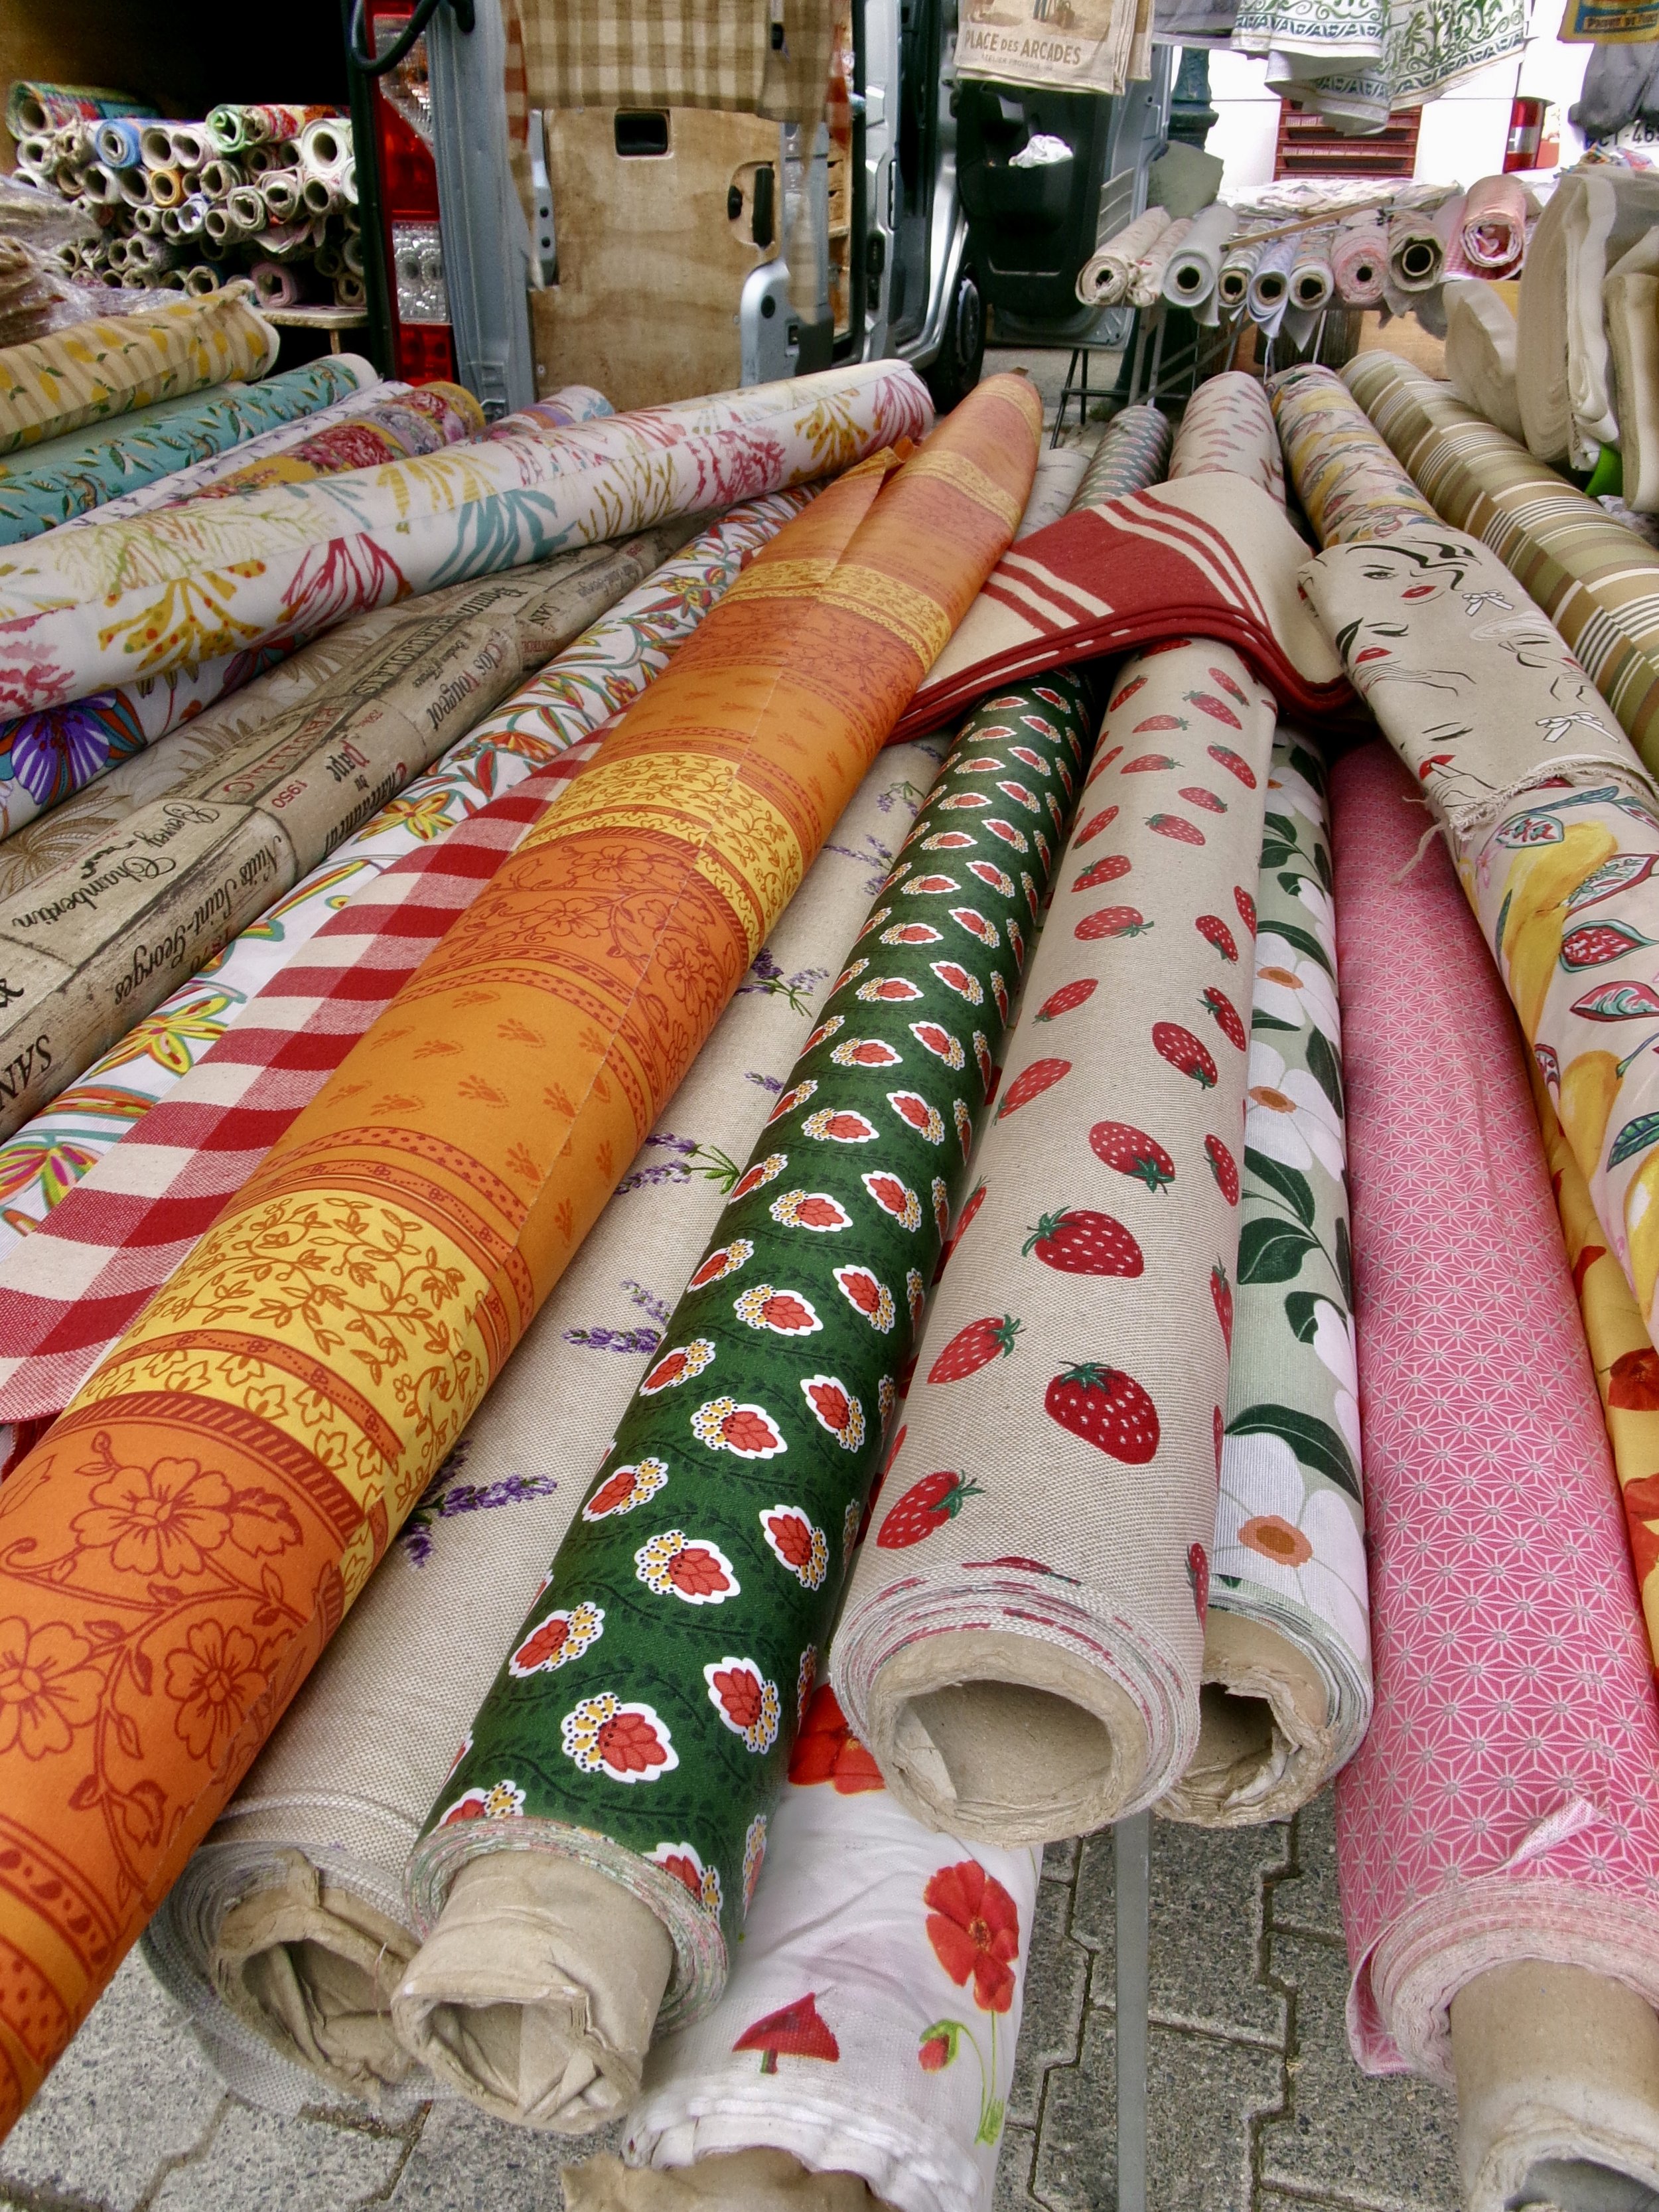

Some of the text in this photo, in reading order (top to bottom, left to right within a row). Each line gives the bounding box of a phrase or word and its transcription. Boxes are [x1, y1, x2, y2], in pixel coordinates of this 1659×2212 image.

[964, 29, 999, 52] PLACE
[1000, 38, 1019, 52] DES
[1020, 38, 1082, 65] ARCADES
[271, 779, 308, 808] 1950
[11, 856, 177, 928] Chambertin
[114, 835, 282, 1005] Nuits Saint-Georges
